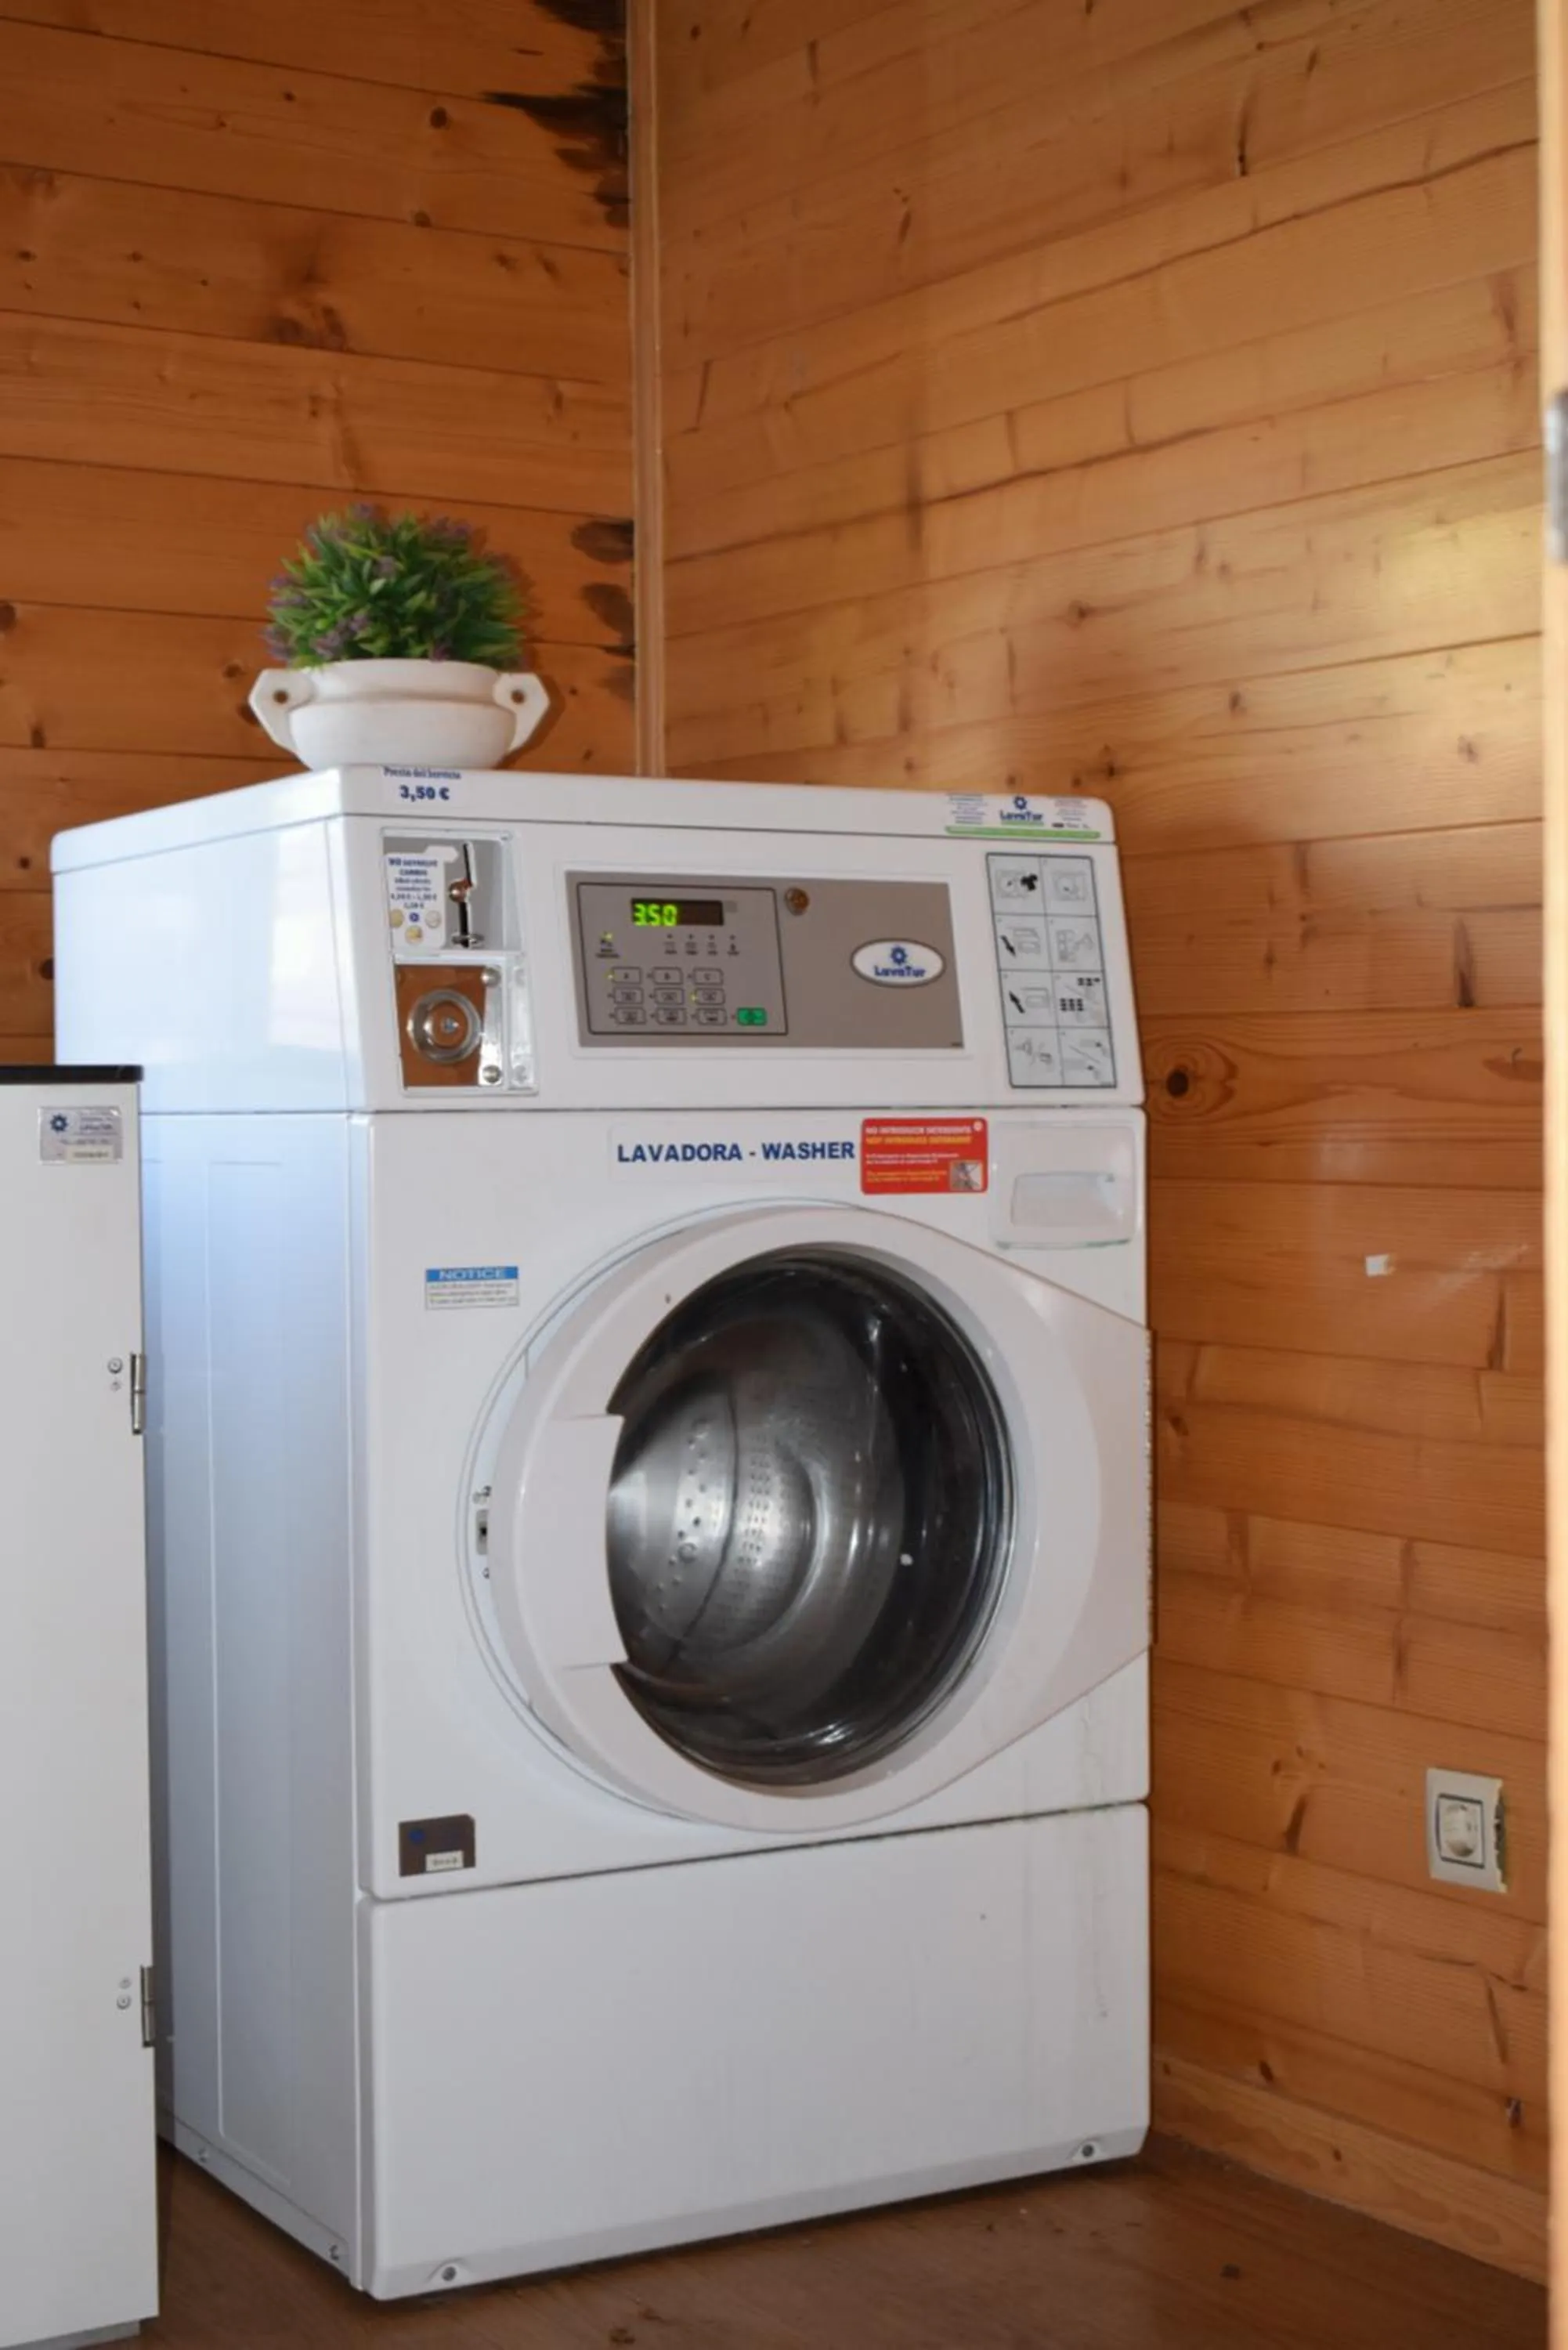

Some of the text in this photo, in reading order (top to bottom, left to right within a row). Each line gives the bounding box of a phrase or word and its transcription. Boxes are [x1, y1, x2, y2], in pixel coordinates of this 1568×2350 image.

[399, 784, 435, 802] 3,50
[873, 964, 926, 978] LavaTur
[617, 1144, 742, 1162] LAVADORA
[761, 1141, 855, 1160] WASHER
[439, 1267, 505, 1280] NOTICE
